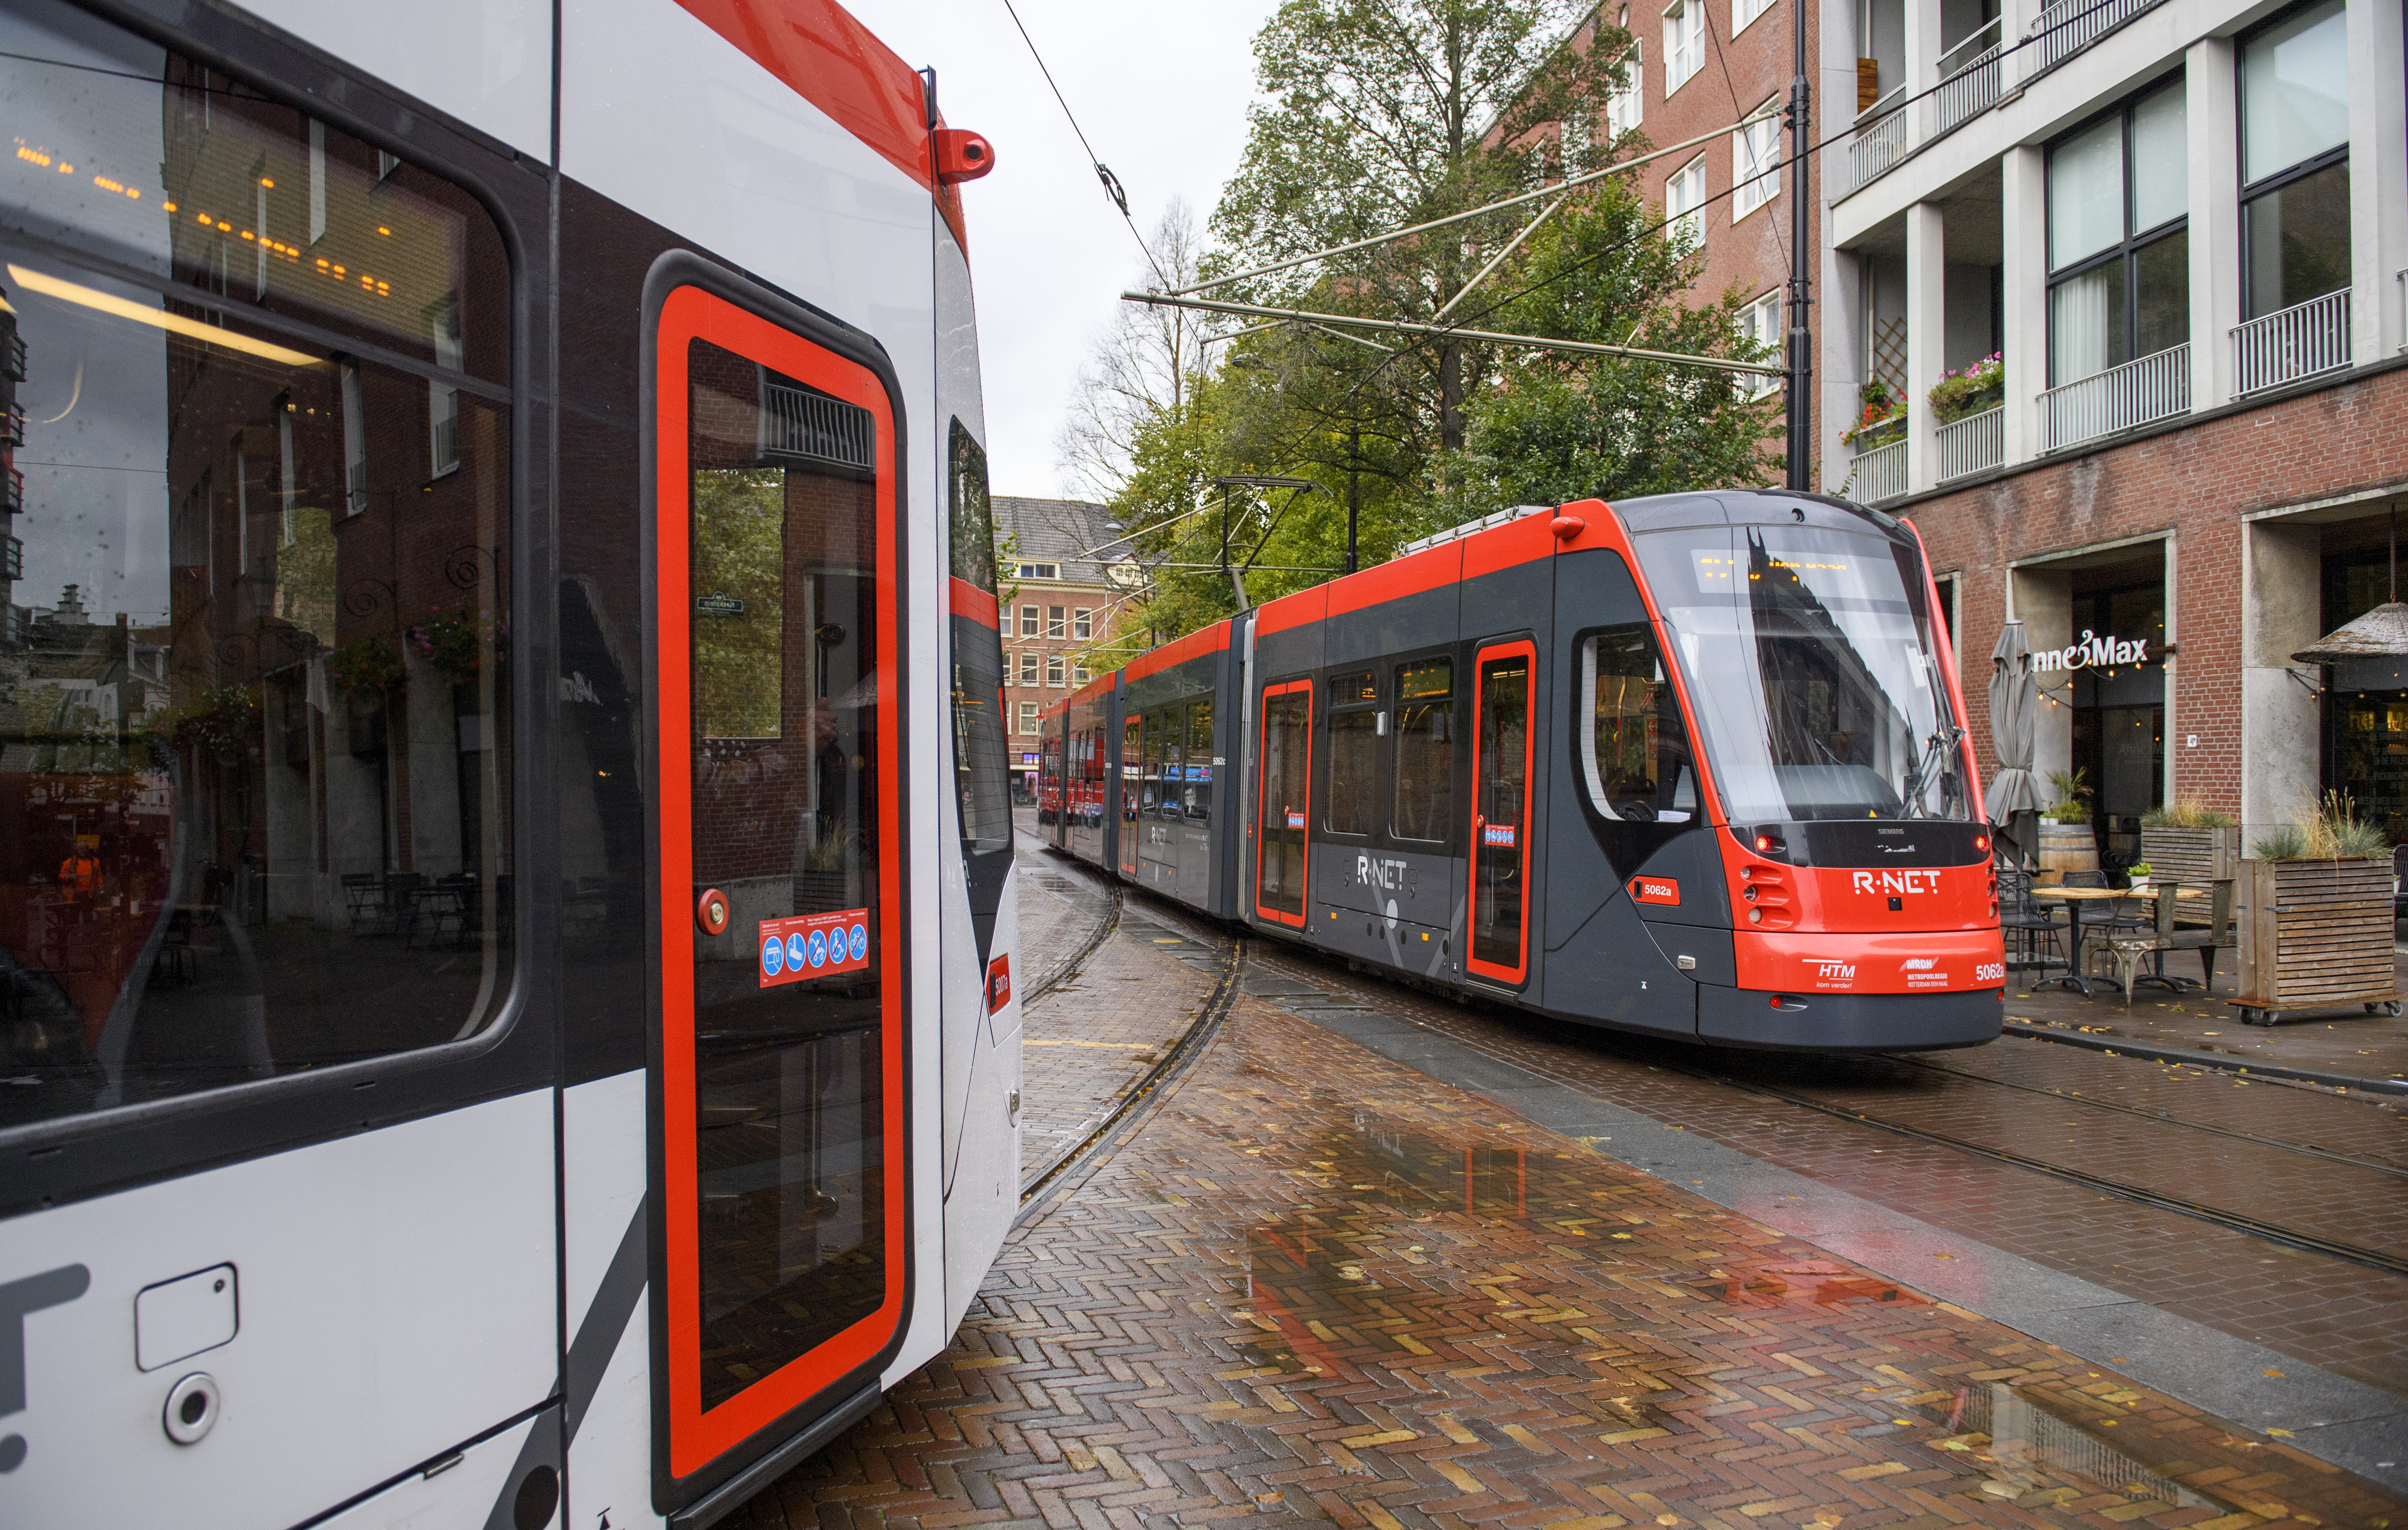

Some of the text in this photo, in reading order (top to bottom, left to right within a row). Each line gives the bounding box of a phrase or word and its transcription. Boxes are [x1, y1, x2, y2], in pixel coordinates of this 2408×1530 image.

[1213, 757, 1226, 765] 5062c
[1645, 884, 1671, 896] 5062a
[1906, 959, 1932, 969] MRDH
[1819, 964, 1856, 977] HTM
[1976, 963, 2004, 981] 5062a
[996, 974, 1008, 996] 5007a
